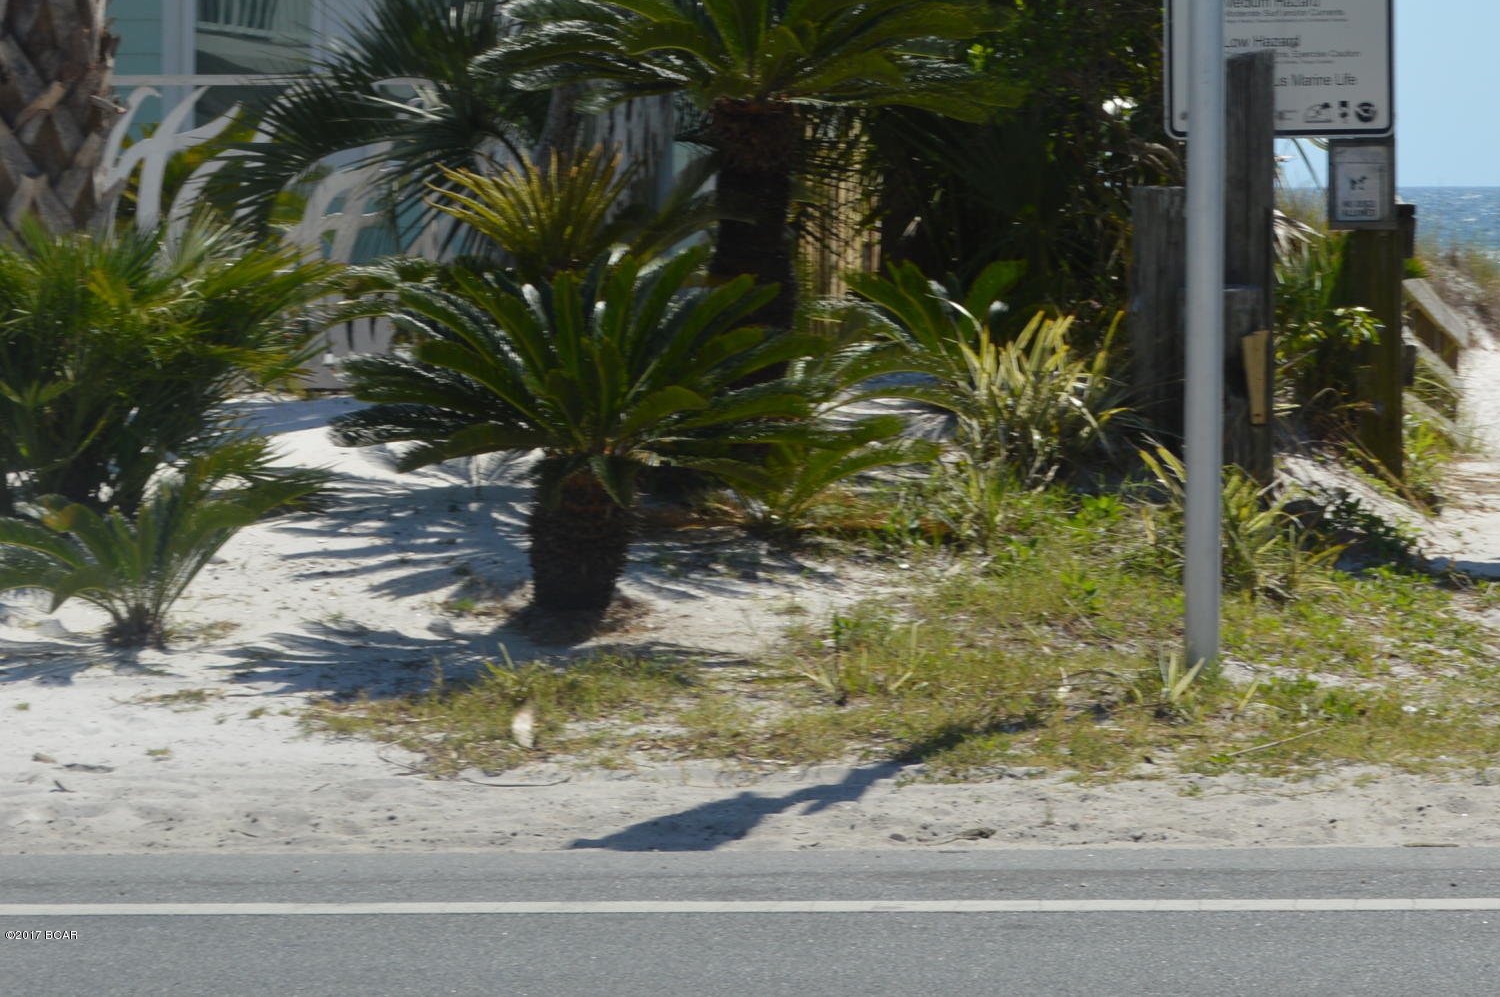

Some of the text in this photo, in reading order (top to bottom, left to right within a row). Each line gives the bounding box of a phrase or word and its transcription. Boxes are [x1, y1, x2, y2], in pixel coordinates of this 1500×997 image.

[1252, 35, 1301, 48] Hazard
[1291, 73, 1332, 86] Marine
[1335, 73, 1358, 86] Life
